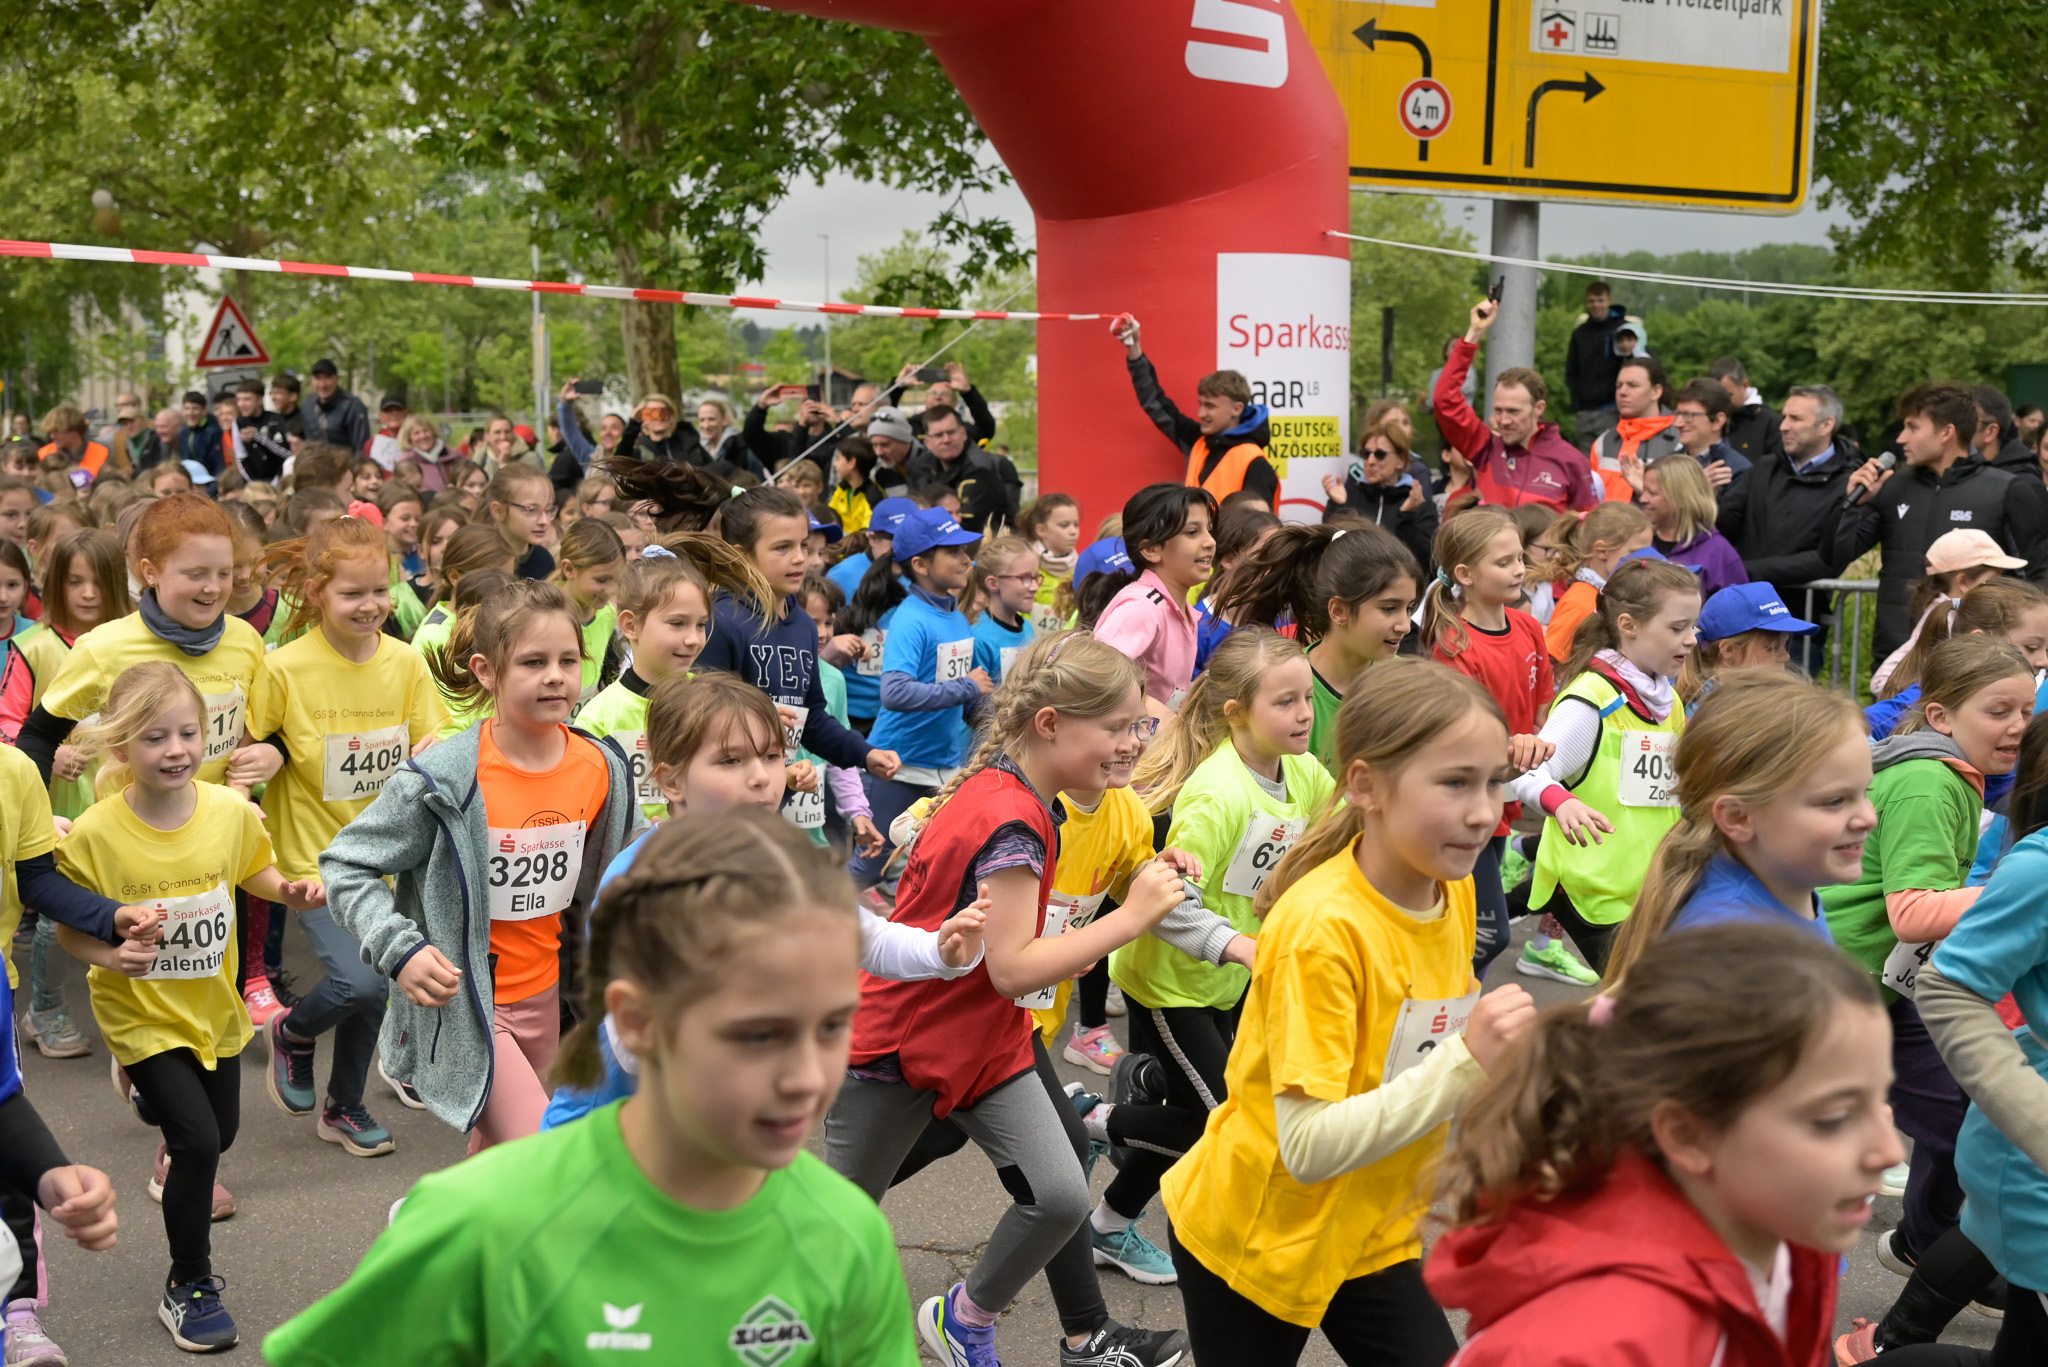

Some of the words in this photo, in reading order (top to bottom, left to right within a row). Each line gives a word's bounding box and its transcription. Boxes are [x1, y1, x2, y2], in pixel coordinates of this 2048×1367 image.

[1666, 0, 1783, 19] reizeitpark
[1412, 97, 1421, 118] 4
[1426, 105, 1439, 119] m
[1271, 422, 1337, 437] DEUTSCH-
[1267, 440, 1340, 458] NZÖSISCHE
[750, 644, 813, 691] YES
[340, 744, 402, 776] 4409
[1633, 754, 1677, 780] 403
[532, 816, 560, 828] TSSH
[796, 811, 822, 823] Lina
[521, 840, 565, 854] Sparkasse
[489, 851, 568, 887] 3298
[122, 885, 138, 896] GS
[159, 876, 201, 891] Oranna
[174, 902, 221, 921] Sparkasse
[511, 893, 545, 912] Ella
